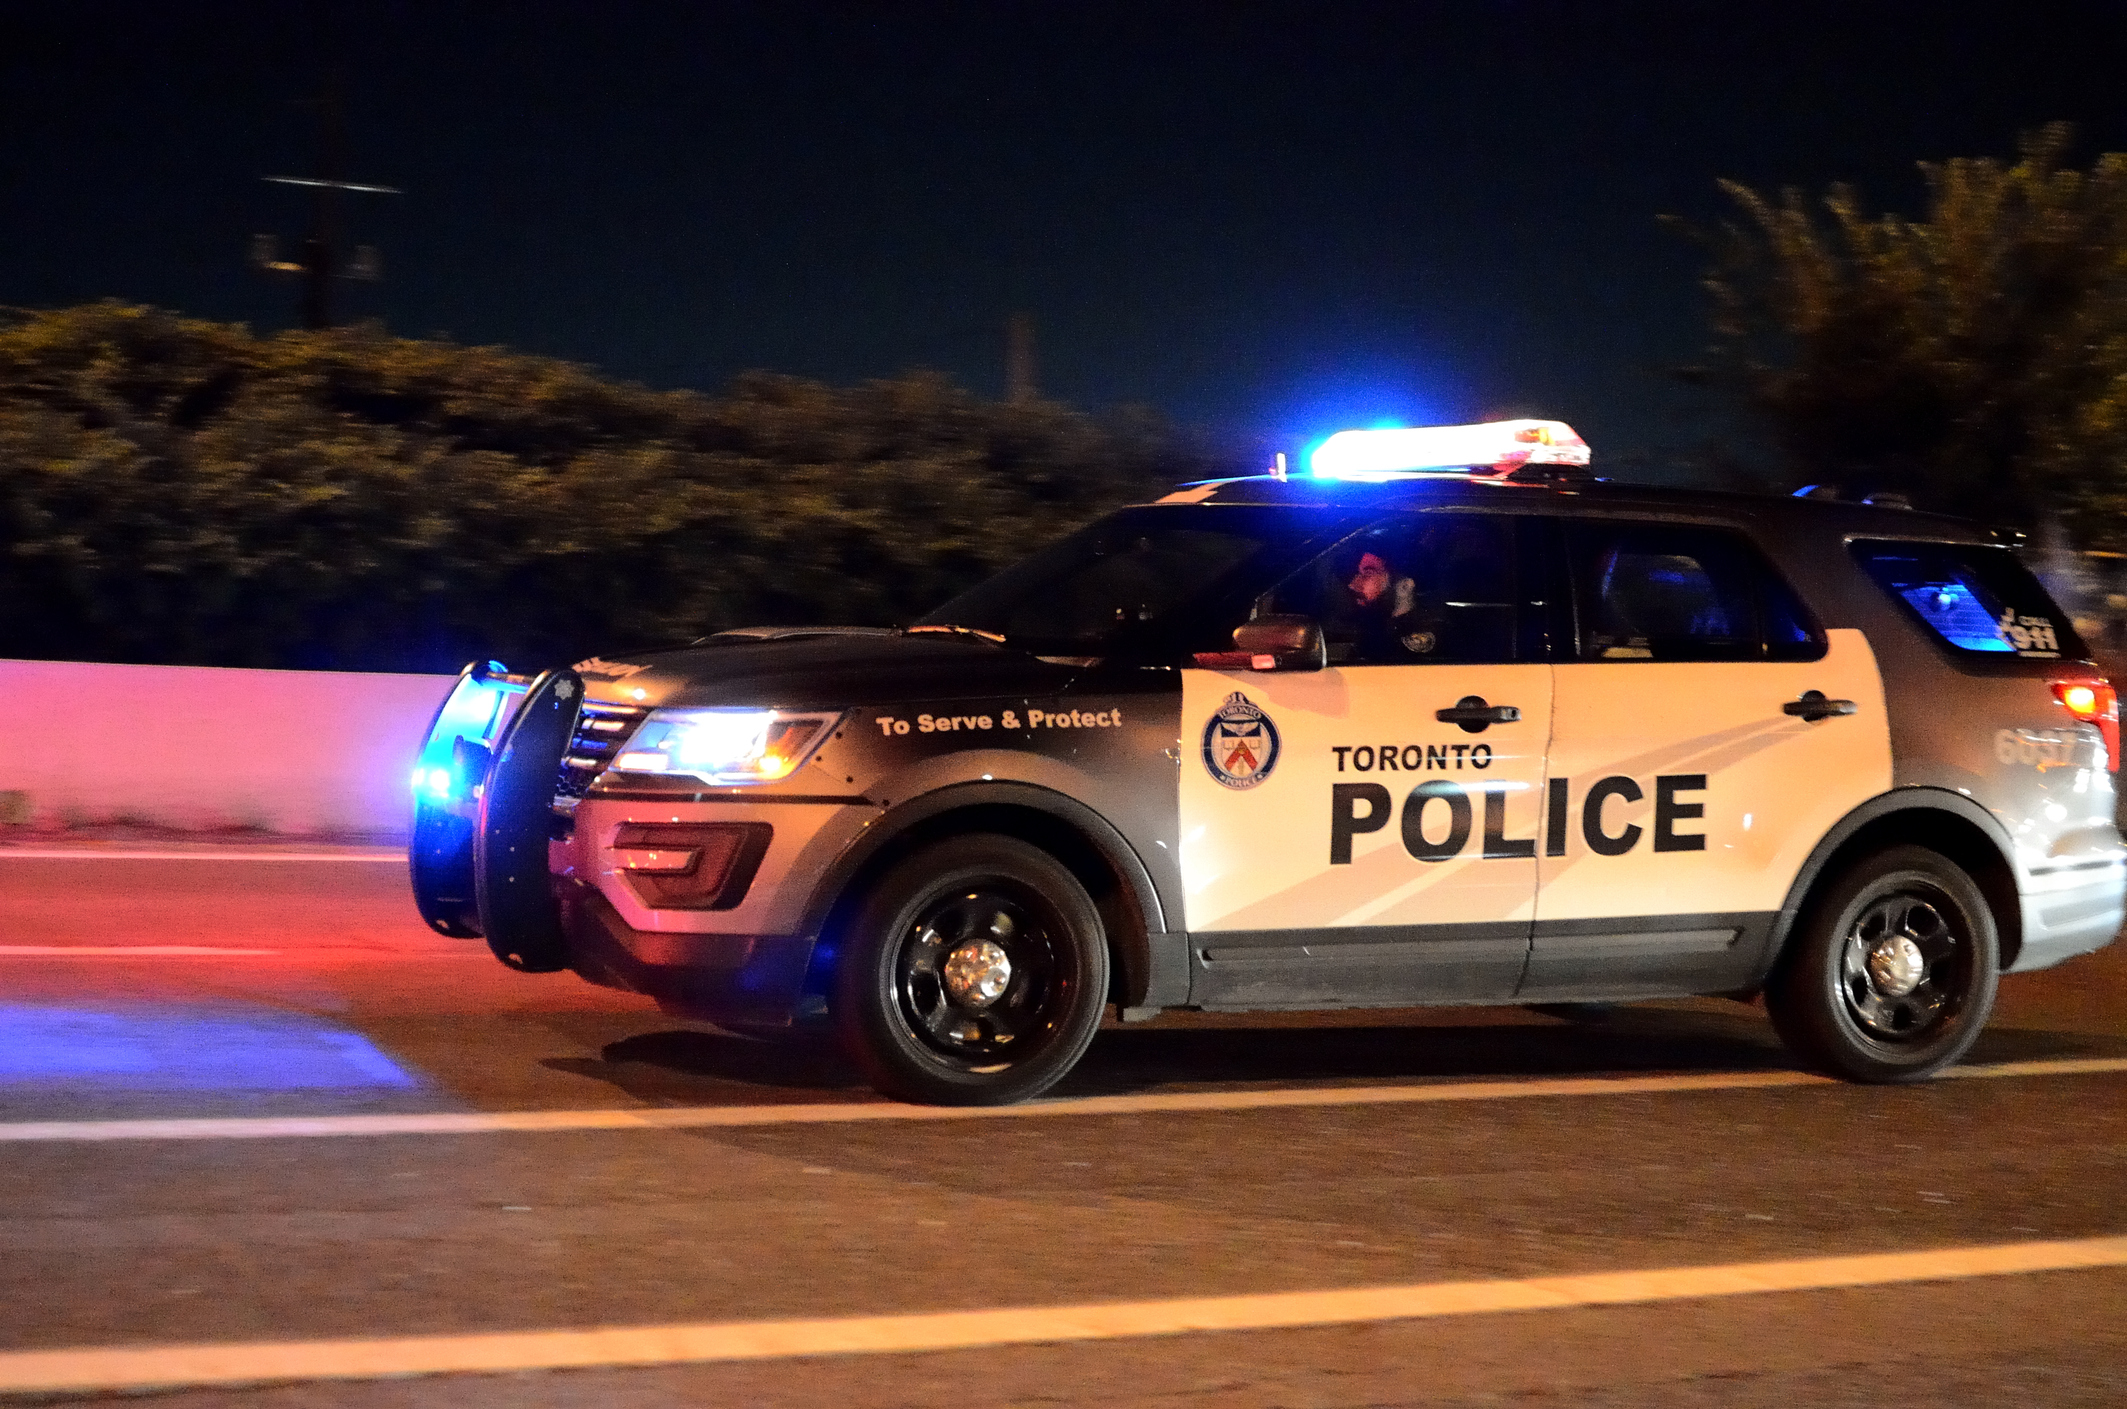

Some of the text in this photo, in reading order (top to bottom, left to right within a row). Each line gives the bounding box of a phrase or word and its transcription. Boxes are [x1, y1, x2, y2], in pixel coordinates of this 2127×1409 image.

[875, 708, 1122, 736] To Serve & Protect
[1331, 743, 1492, 772] TORONTO
[1329, 773, 1708, 866] POLICE
